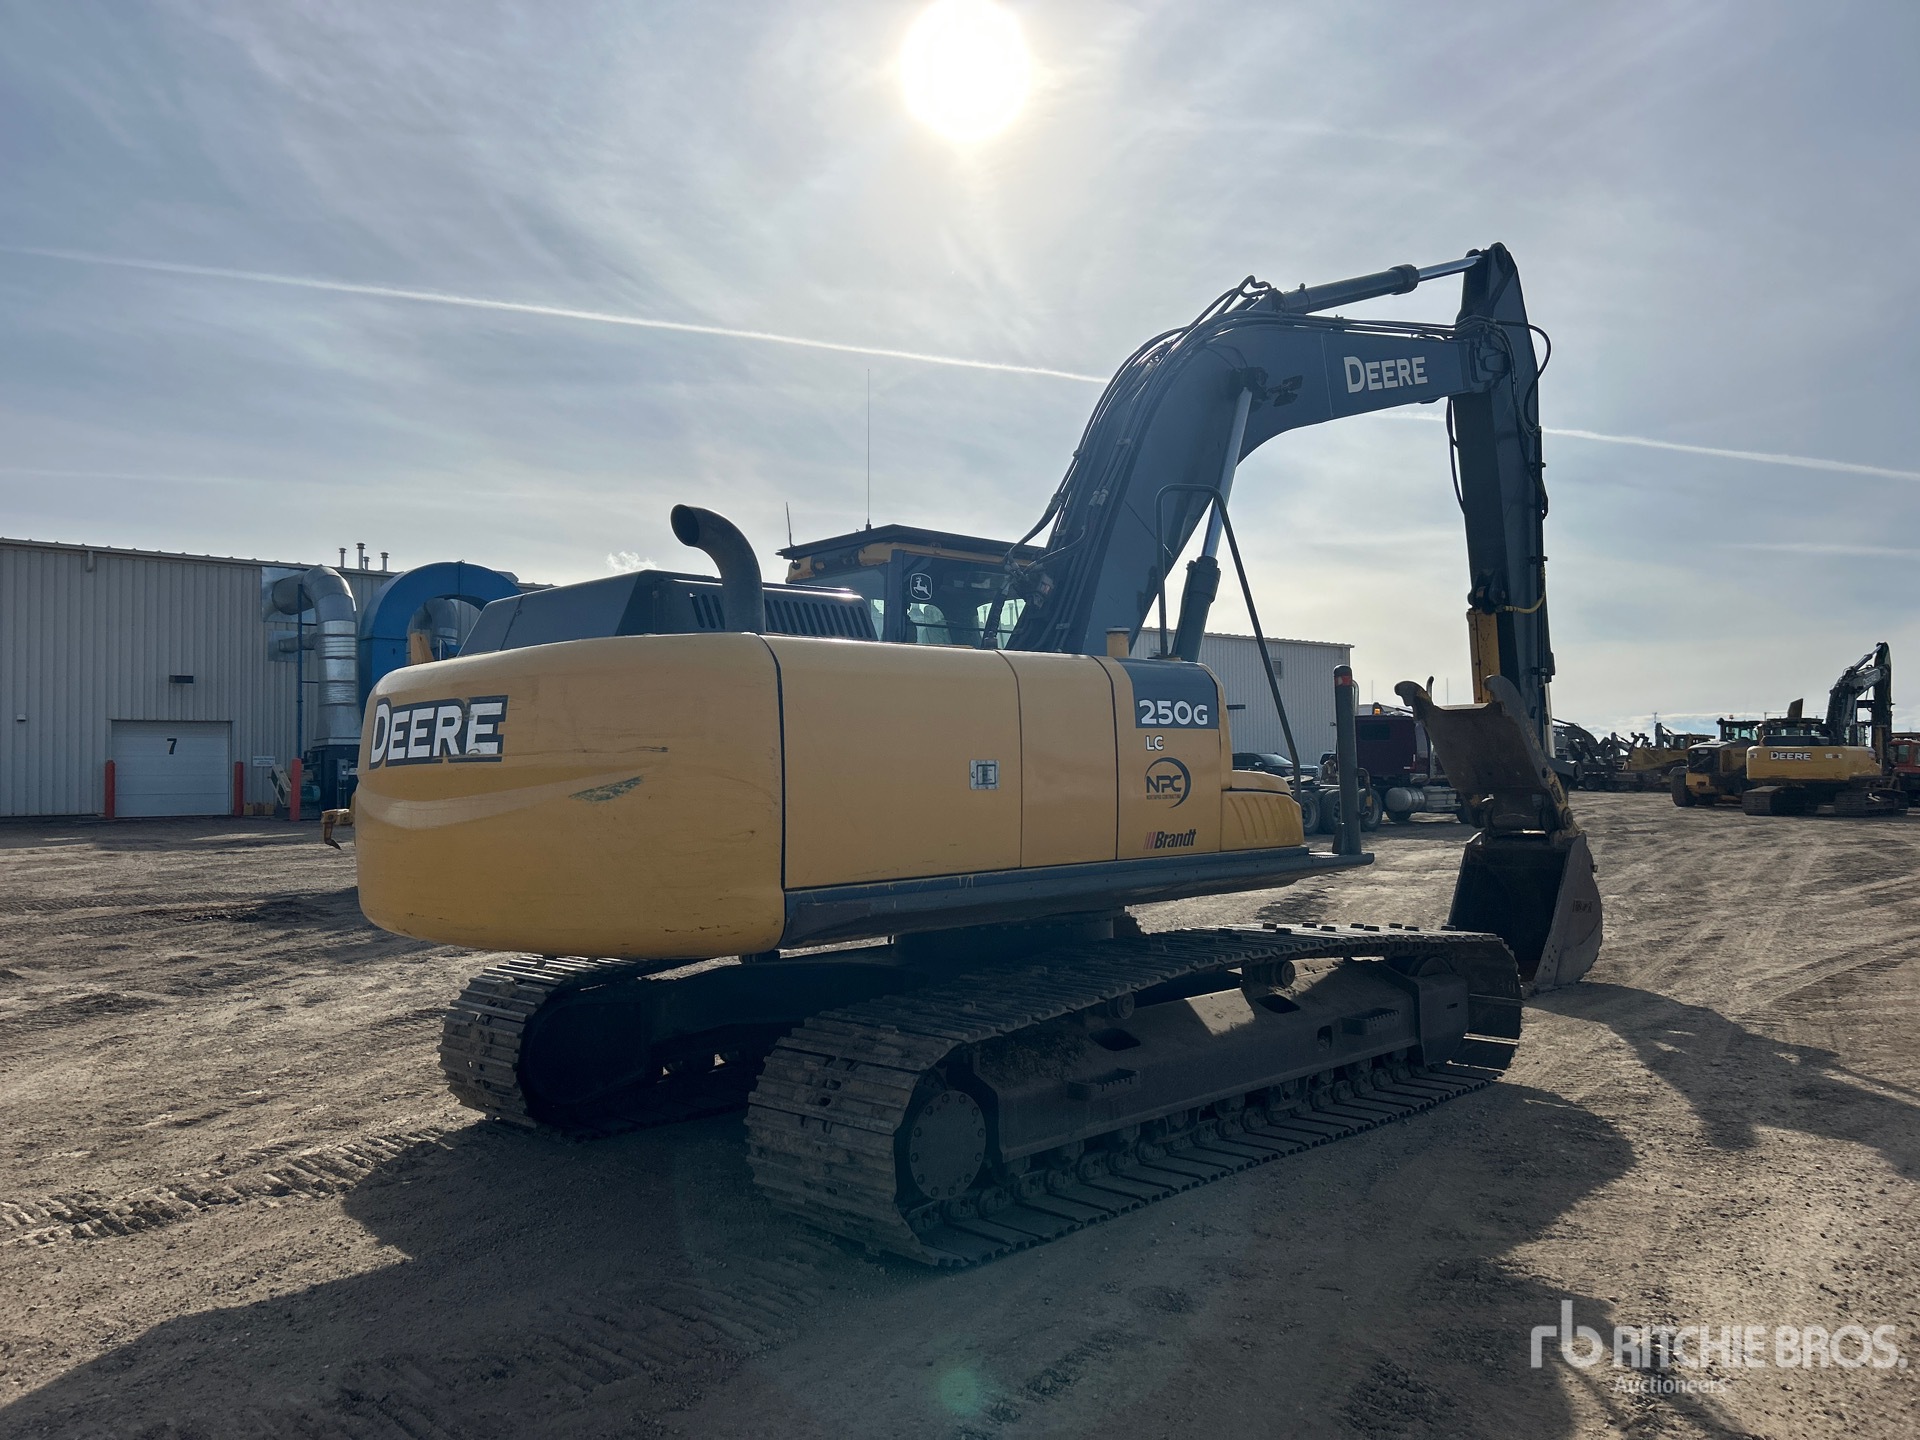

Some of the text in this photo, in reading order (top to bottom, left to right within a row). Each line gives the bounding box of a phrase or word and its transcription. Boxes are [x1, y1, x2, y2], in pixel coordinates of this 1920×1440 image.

[1343, 355, 1428, 393] DEERE
[1138, 699, 1208, 726] 250G
[370, 701, 504, 765] DEERE
[167, 738, 177, 755] 7
[1146, 735, 1165, 751] LC
[1770, 751, 1812, 761] DEERE
[1146, 774, 1182, 793] NPC
[1154, 829, 1197, 849] Brandt
